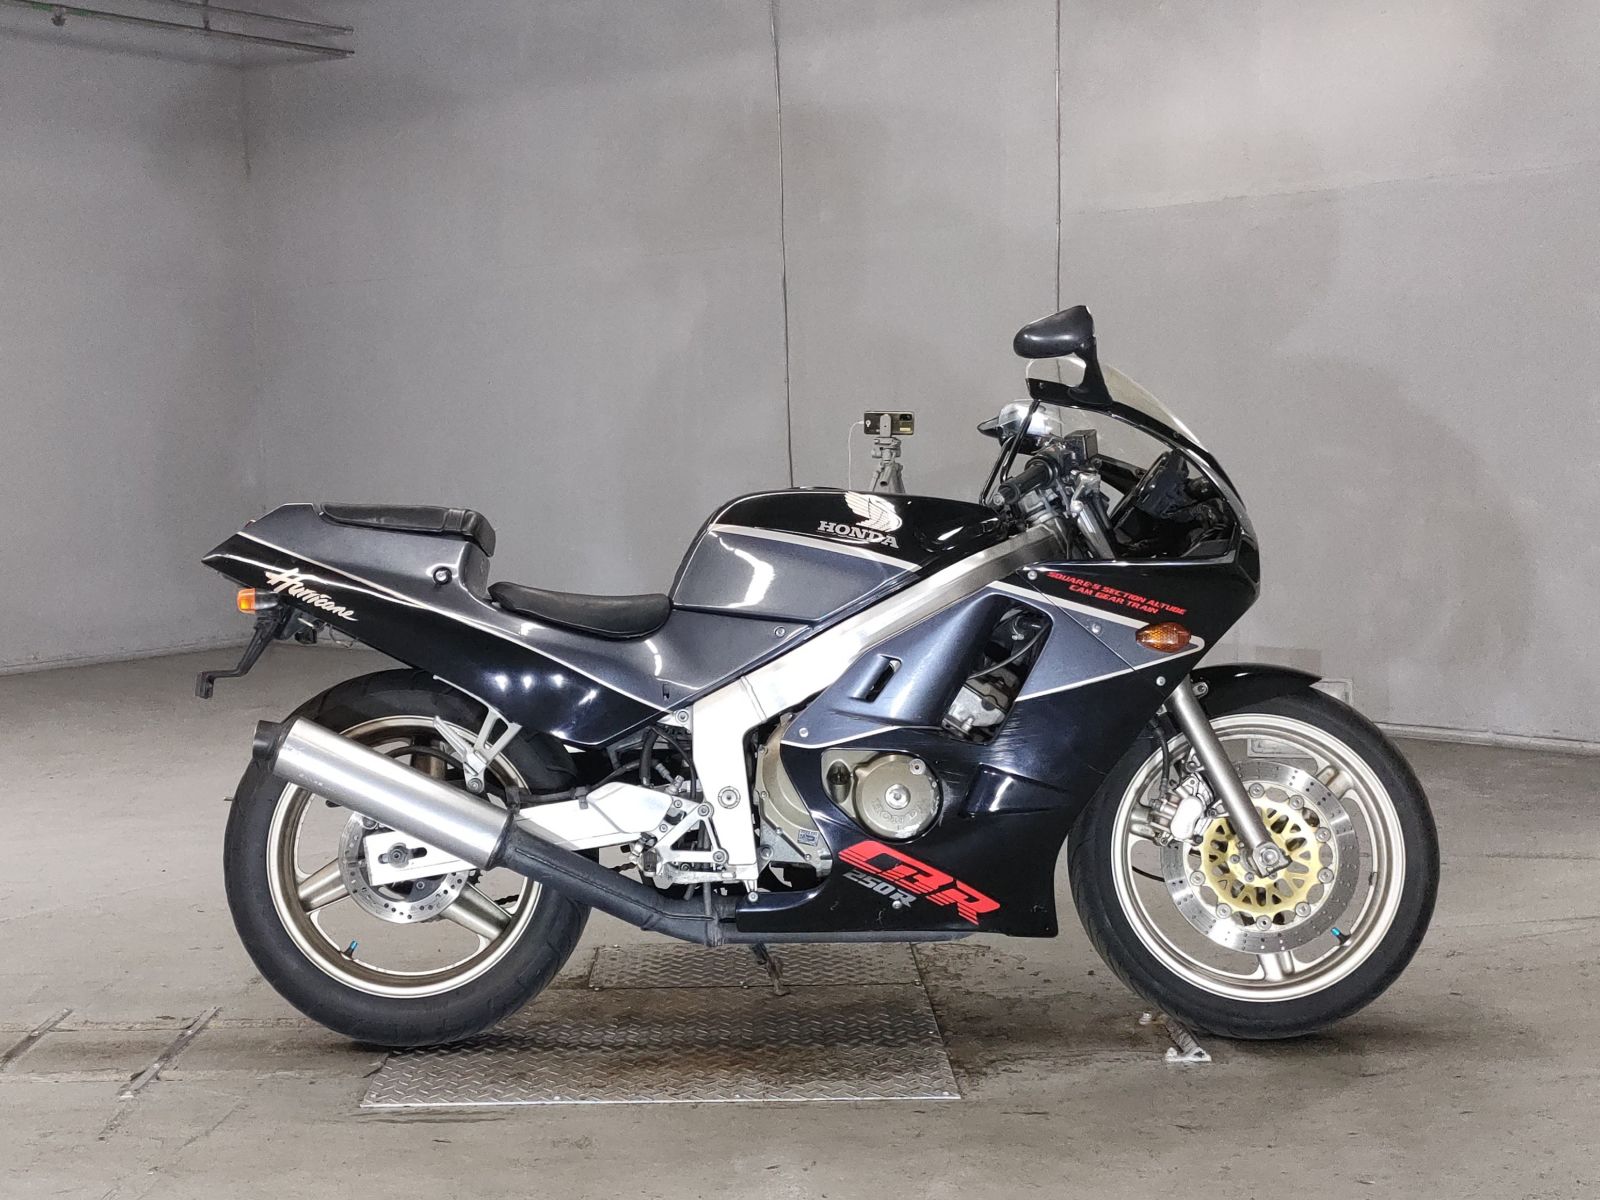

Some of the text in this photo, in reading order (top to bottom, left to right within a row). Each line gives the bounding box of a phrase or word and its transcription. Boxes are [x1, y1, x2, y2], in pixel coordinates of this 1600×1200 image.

[817, 520, 899, 549] HONDA
[264, 567, 358, 621] Hurricane
[1068, 584, 1159, 614] CAM GEAR TRAIN
[1102, 586, 1146, 602] SECTION
[838, 840, 1001, 926] CBR
[842, 869, 917, 908] 250R
